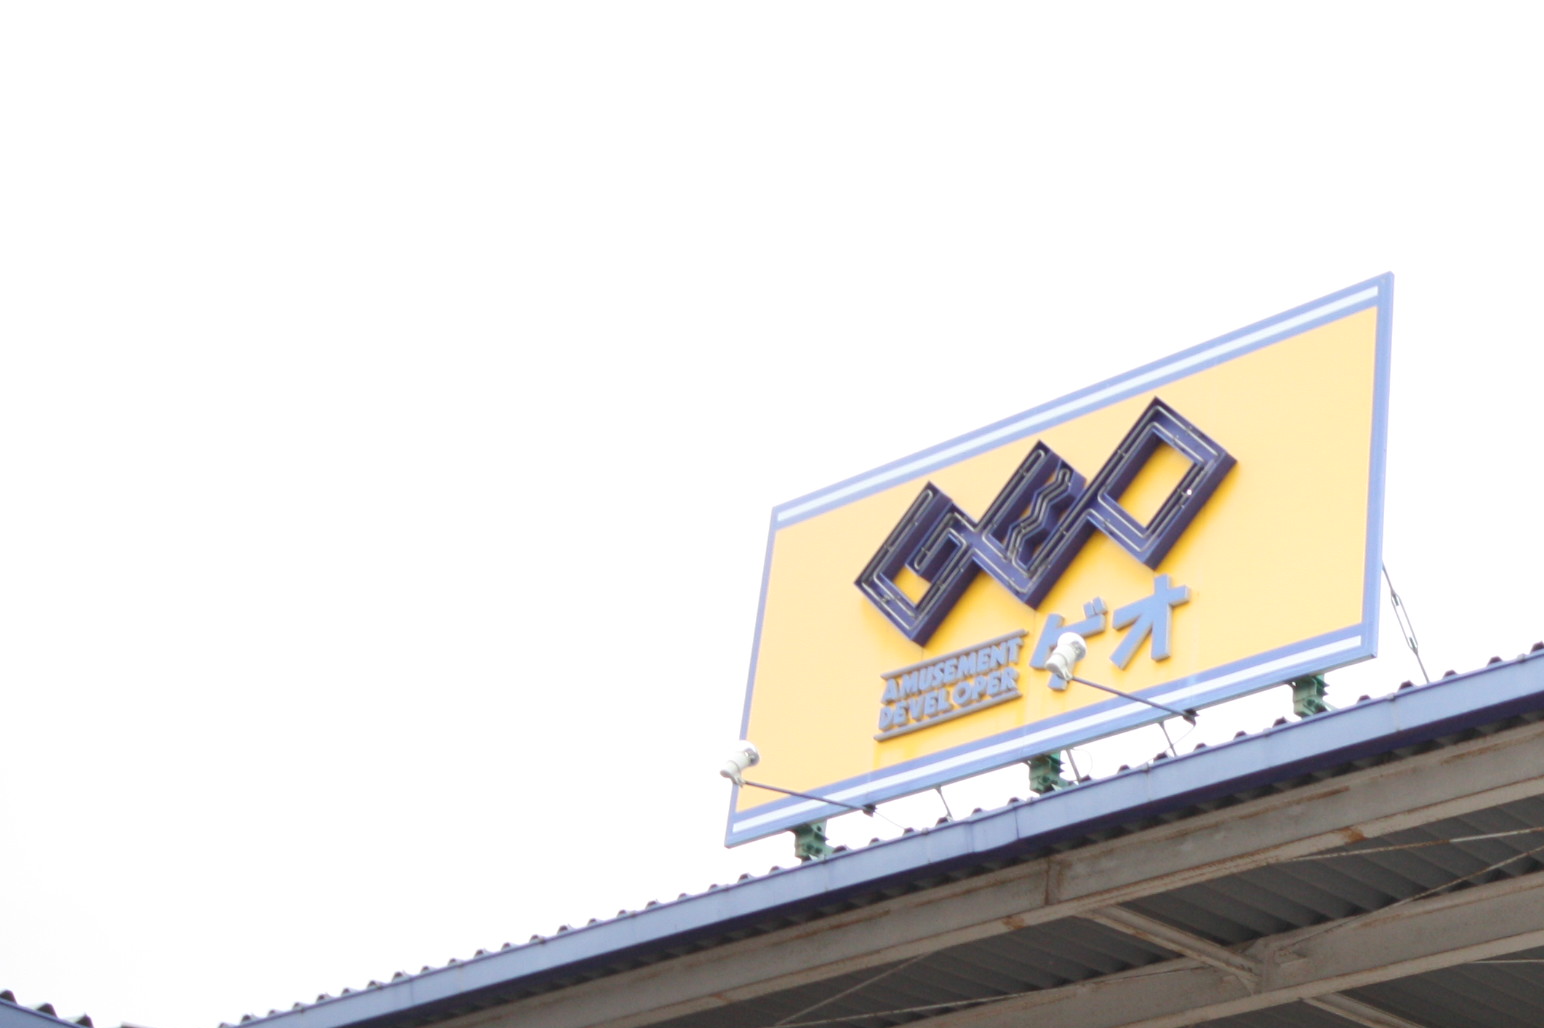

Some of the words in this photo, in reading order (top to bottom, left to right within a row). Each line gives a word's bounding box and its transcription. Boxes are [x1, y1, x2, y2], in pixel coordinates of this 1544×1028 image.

[854, 395, 1238, 648] GEO
[883, 632, 1024, 706] AMUSEMENT
[1030, 573, 1190, 690] ゲオ
[877, 668, 1021, 730] DEVELOPER
